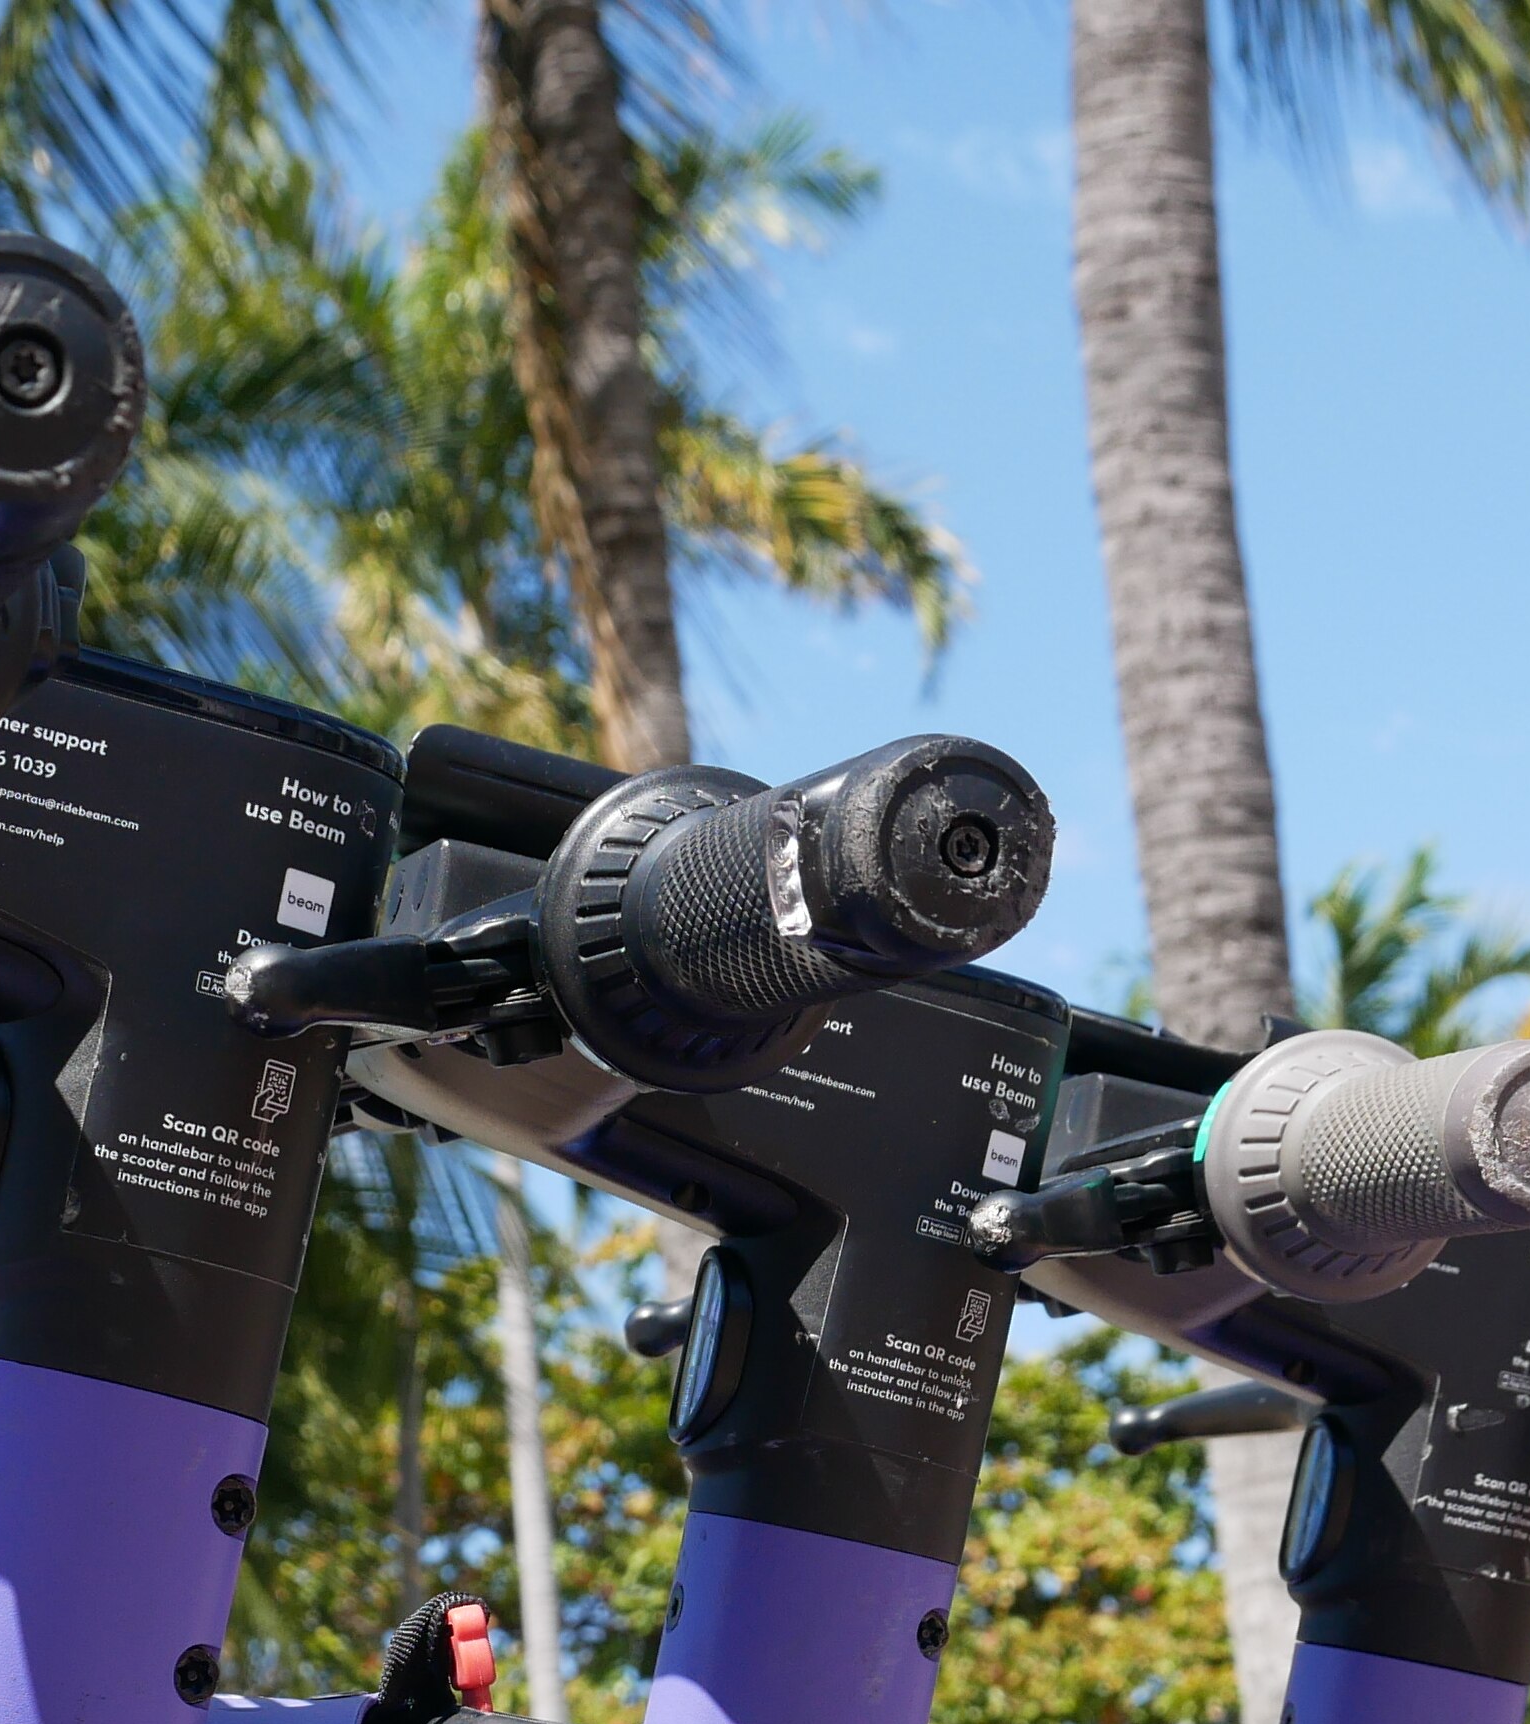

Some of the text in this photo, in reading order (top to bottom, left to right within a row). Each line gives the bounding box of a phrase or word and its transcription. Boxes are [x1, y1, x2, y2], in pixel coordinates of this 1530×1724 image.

[33, 725, 108, 756] support
[13, 754, 56, 778] 1039
[281, 777, 351, 816] How to
[245, 802, 345, 845] use Beam
[287, 891, 325, 914] beam
[991, 1053, 1042, 1085] How to
[962, 1074, 1036, 1109] use Beam
[162, 1114, 280, 1157] Scan QR code
[94, 1144, 271, 1198] the scooter and follow the
[119, 1132, 276, 1180] on handlebar to unlock
[991, 1149, 1019, 1167] beam
[117, 1169, 268, 1218] instructions in the app
[934, 1199, 953, 1214] the
[885, 1333, 976, 1371] Scan QR code
[1512, 1356, 1530, 1369] the
[828, 1358, 849, 1372] the
[851, 1365, 894, 1384] scooter
[896, 1377, 919, 1391] and
[921, 1382, 953, 1400] follow
[849, 1349, 972, 1389] on handlebar to unlock
[846, 1379, 965, 1422] instructions in the app
[1444, 1488, 1458, 1497] on
[1460, 1488, 1511, 1508] handlebar
[1474, 1473, 1506, 1490] Scan
[1508, 1481, 1528, 1495] QR
[1427, 1496, 1445, 1509] the
[1446, 1502, 1485, 1516] scooter
[1485, 1510, 1506, 1521] and
[1443, 1513, 1501, 1534] instructions
[1502, 1526, 1512, 1536] in
[1513, 1529, 1528, 1540] the
